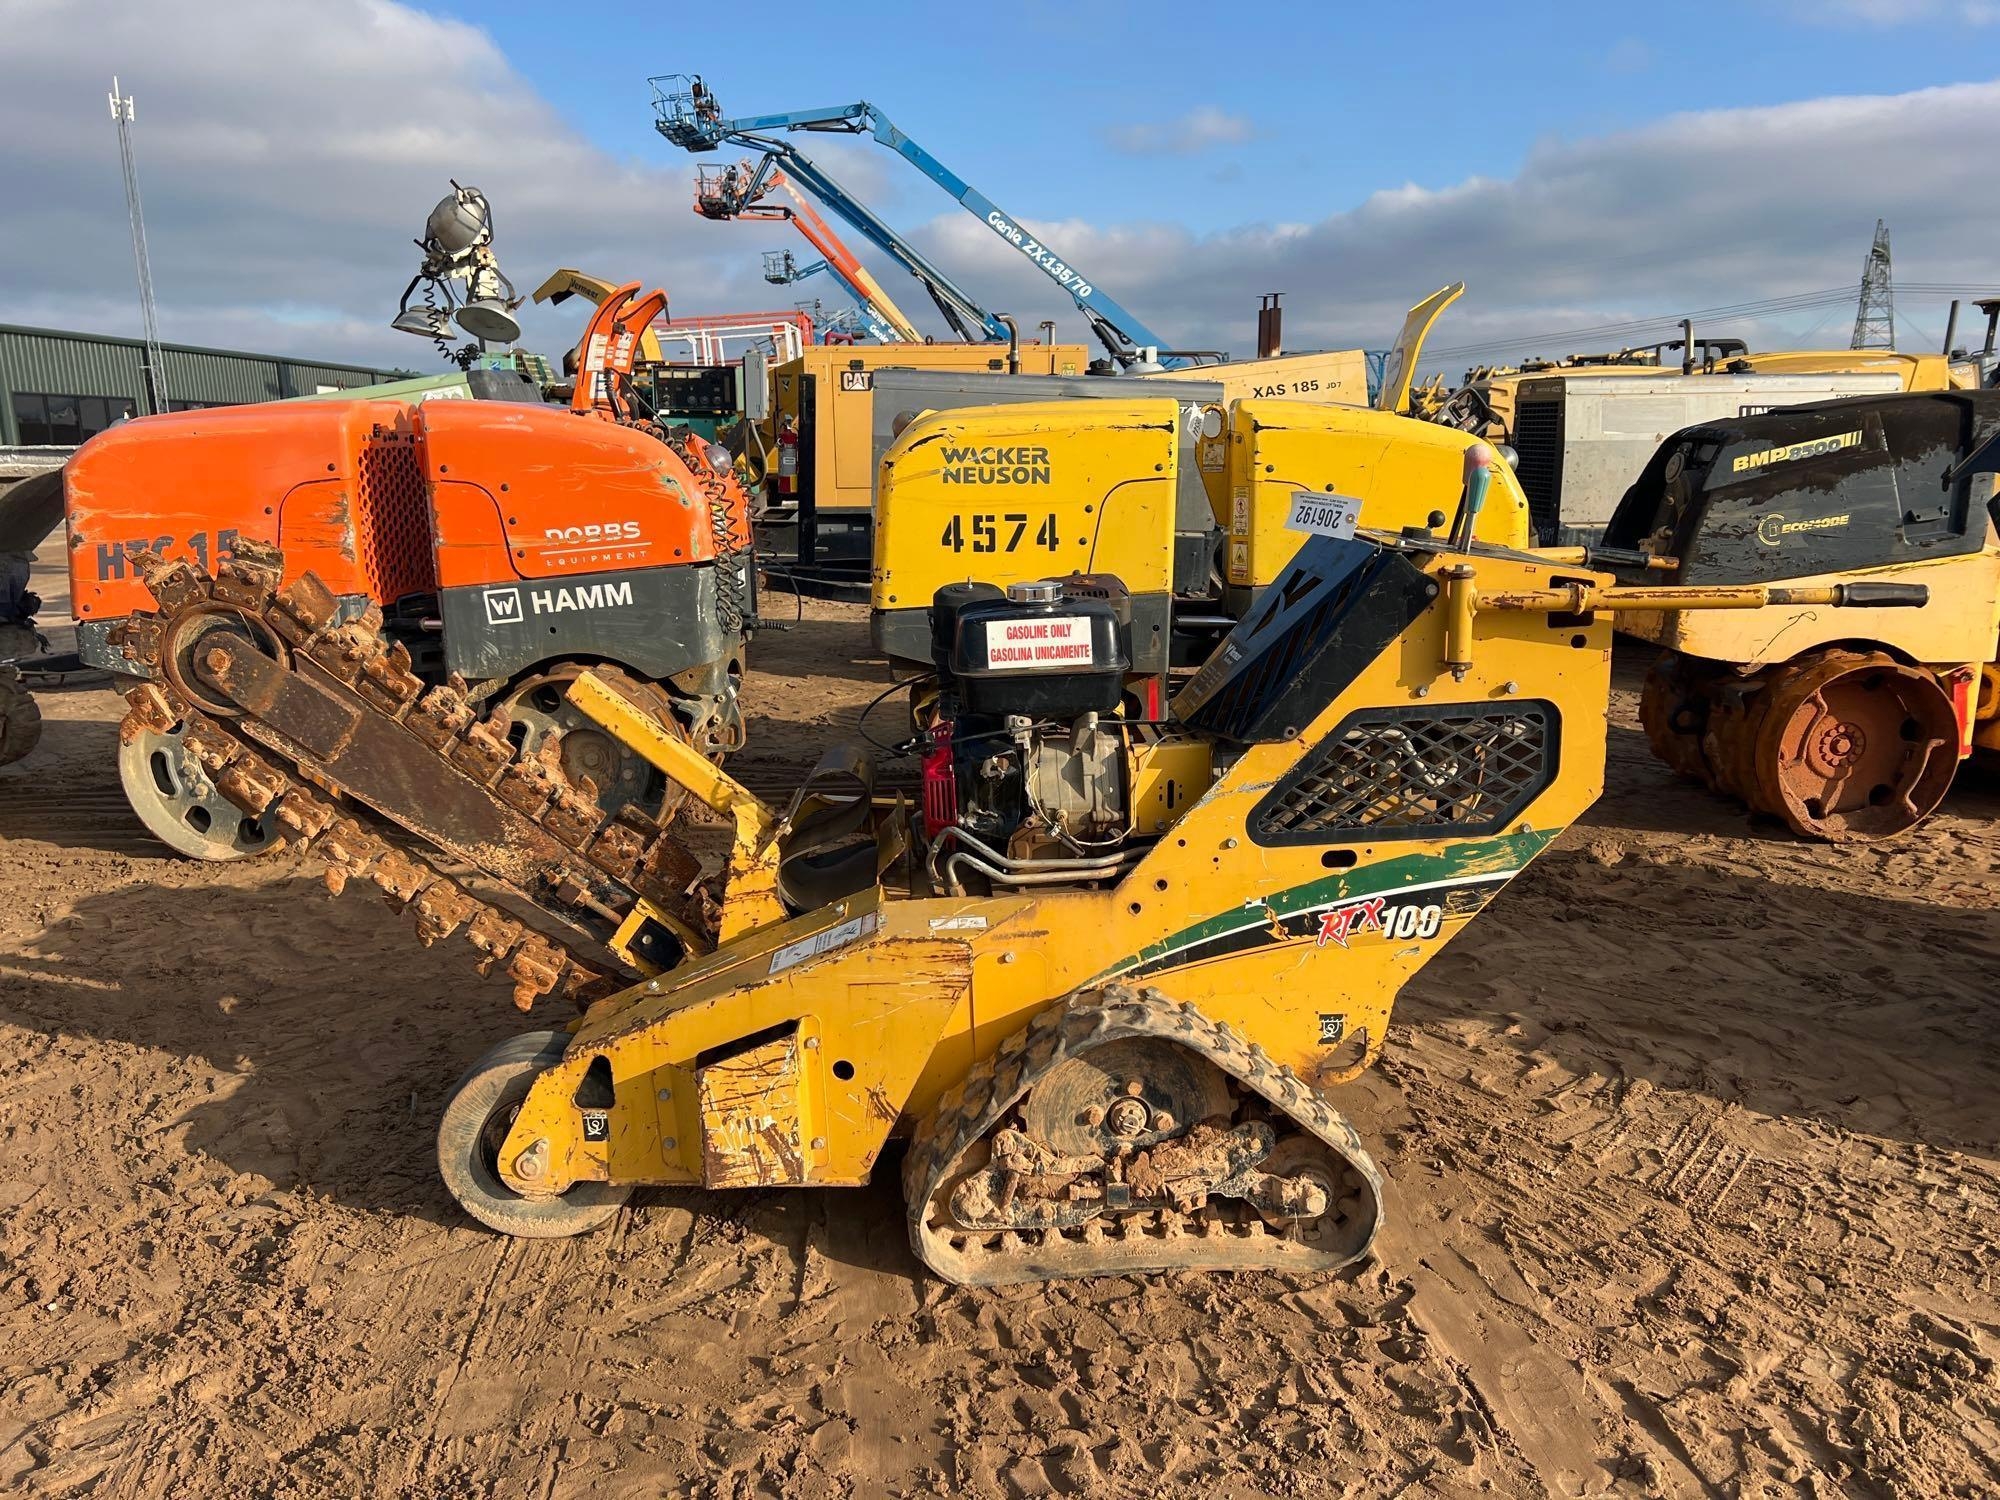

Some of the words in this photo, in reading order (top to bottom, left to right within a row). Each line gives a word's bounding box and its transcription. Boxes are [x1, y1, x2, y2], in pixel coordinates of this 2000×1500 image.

[988, 211, 1023, 246] Genie
[1022, 239, 1093, 298] ZX-135/70
[843, 372, 871, 391] CAT
[1253, 383, 1286, 399] XAS
[1292, 379, 1319, 393] 185
[1326, 381, 1342, 390] JD7
[940, 446, 1051, 465] WACKER
[1732, 437, 1843, 473] BMP8500
[942, 466, 1051, 485] NEUSON
[1295, 505, 1343, 529] 206192
[1781, 514, 1851, 534] ECOMODE
[544, 521, 642, 547] DOBBS
[941, 513, 1060, 553] 4574
[187, 528, 239, 570] 15
[546, 550, 648, 568] EQUIPMENT
[531, 581, 634, 615] HAMM
[1006, 625, 1049, 641] GASOLINE
[1050, 623, 1073, 638] ONLY
[990, 646, 1034, 663] GASOLINA
[1035, 643, 1091, 661] UNICAMENTE
[1381, 904, 1442, 940] 100
